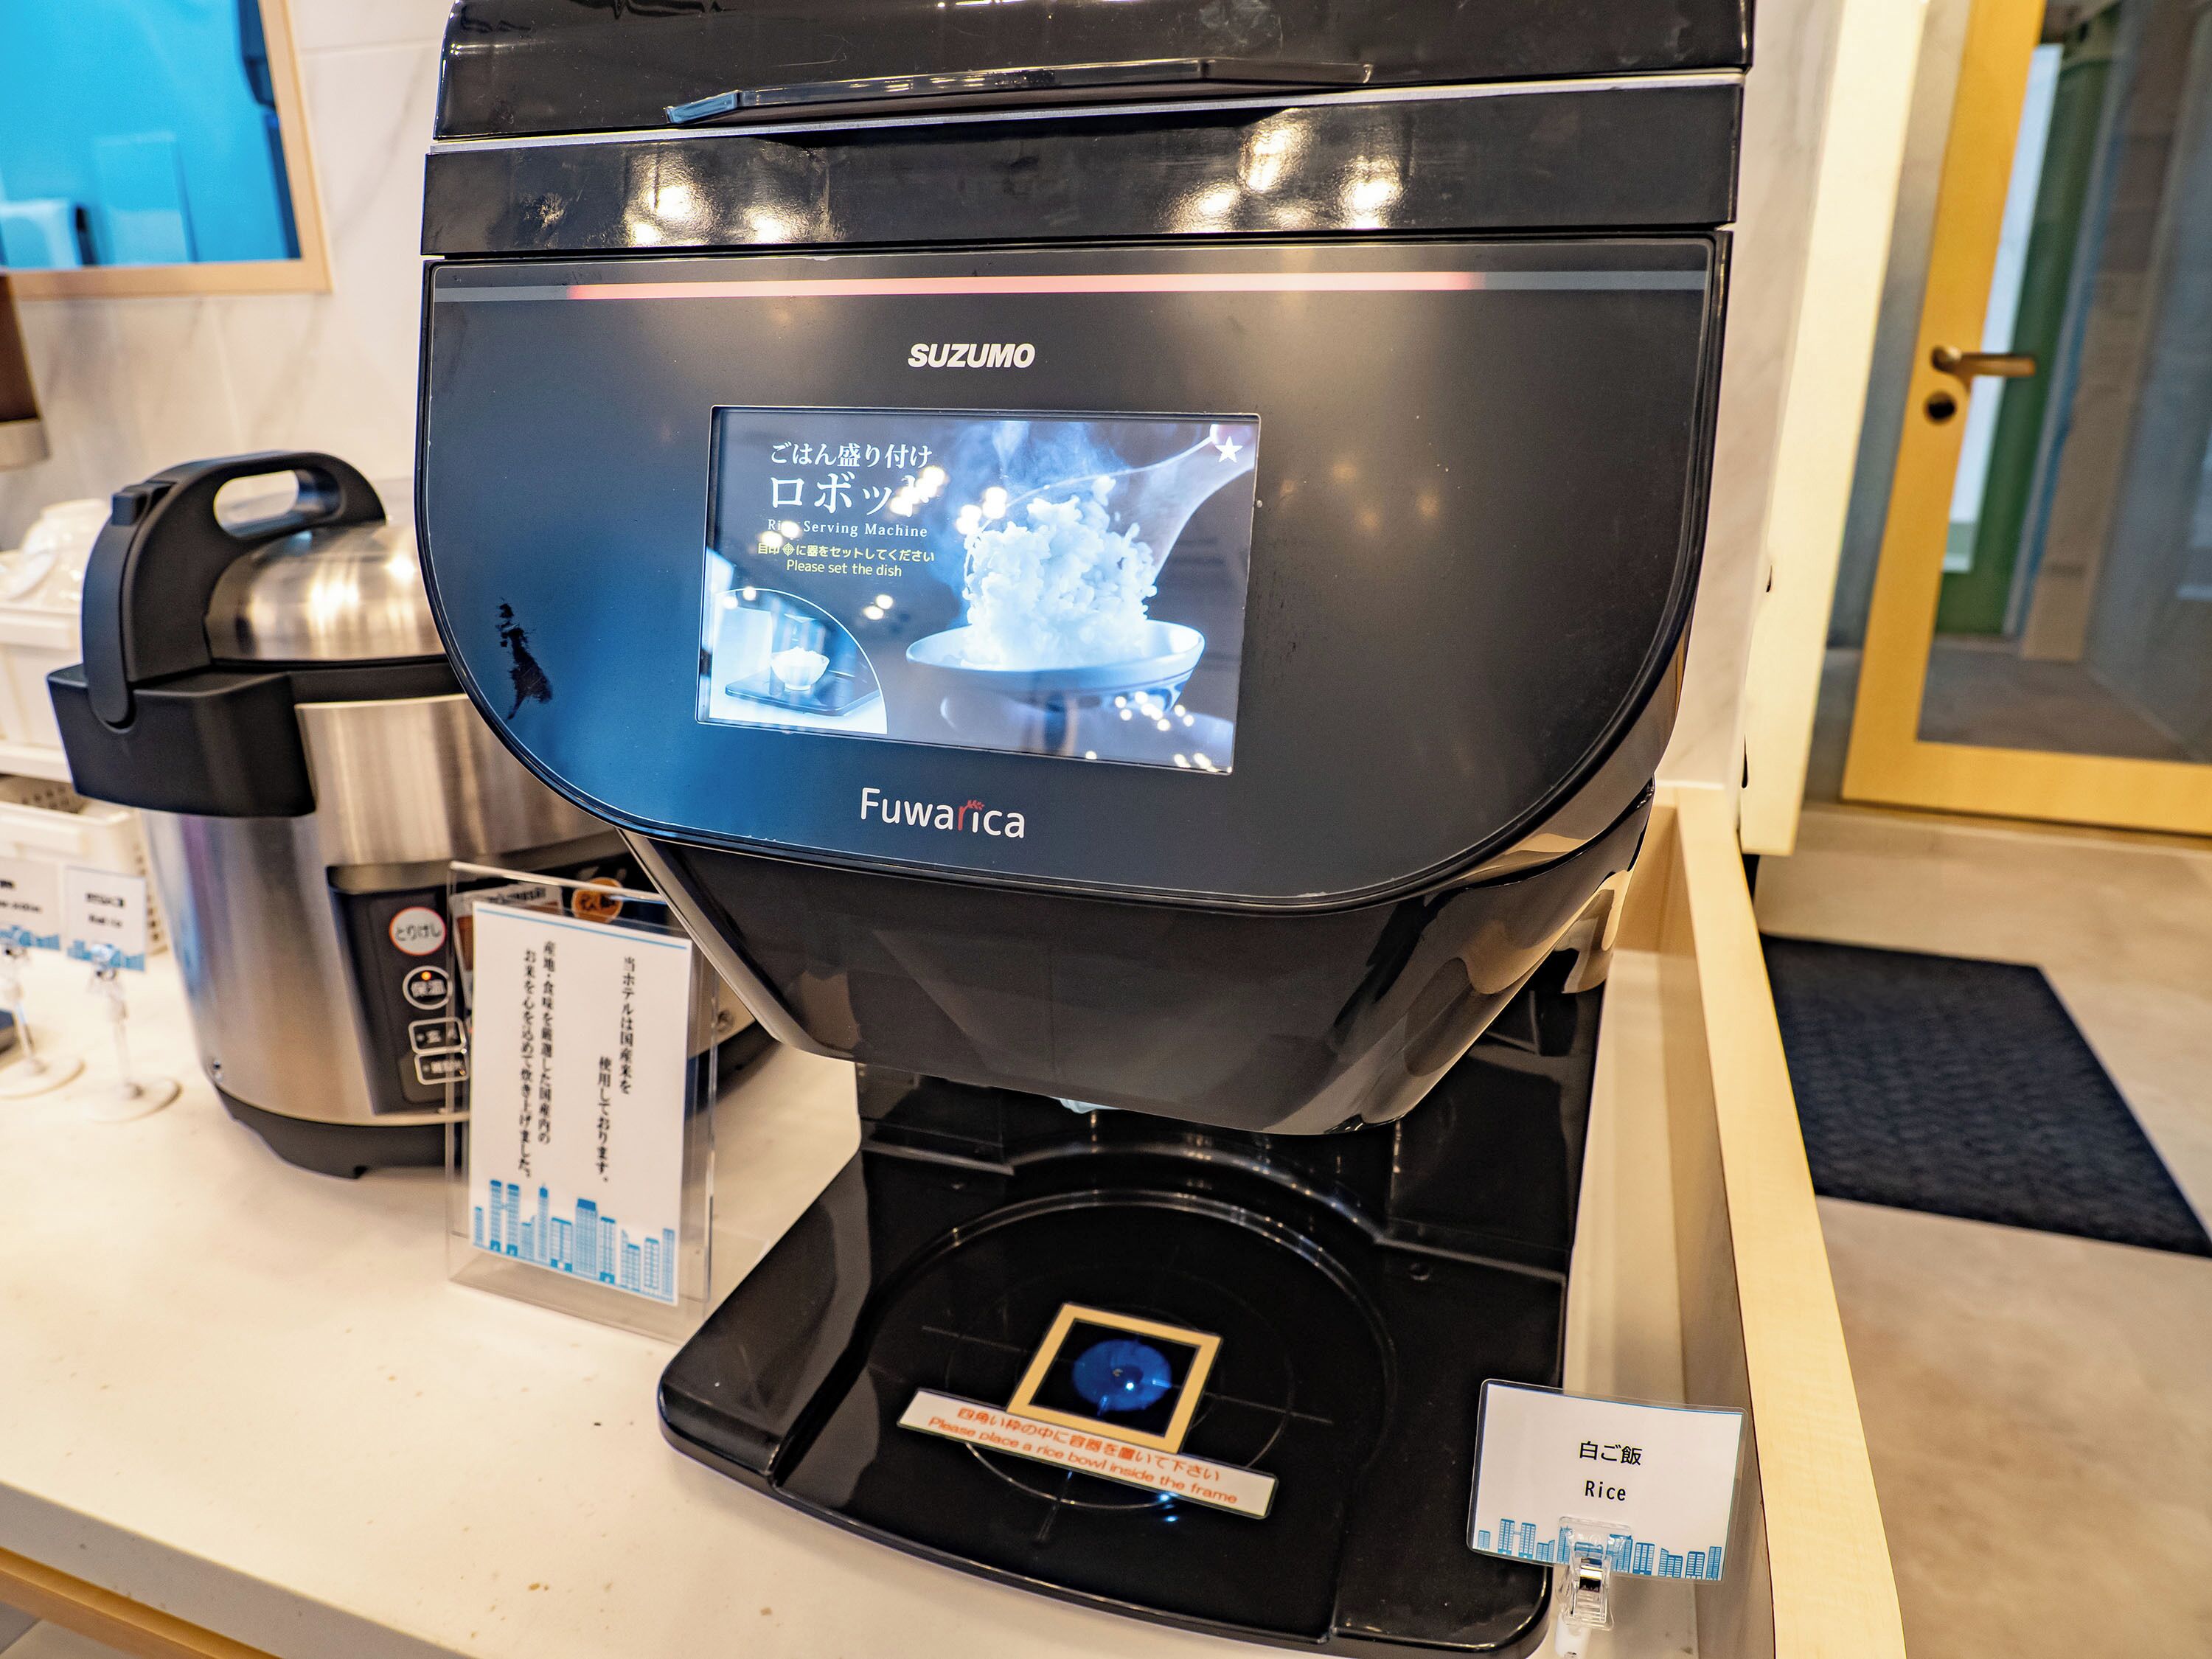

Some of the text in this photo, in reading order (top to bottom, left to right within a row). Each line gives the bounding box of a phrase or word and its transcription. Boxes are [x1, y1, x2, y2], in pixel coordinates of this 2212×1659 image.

[908, 343, 1036, 369] SUZUMO
[771, 441, 933, 469] ごはん盛り付け
[803, 520, 859, 538] Serving
[864, 522, 928, 538] Machine
[786, 558, 903, 577] Please set the dish
[860, 787, 1026, 839] Fuwarica
[928, 1416, 1238, 1505] Please place a rice bowl inside the frame
[1579, 1440, 1643, 1466] 白ご飯
[1585, 1480, 1627, 1501] Rice
